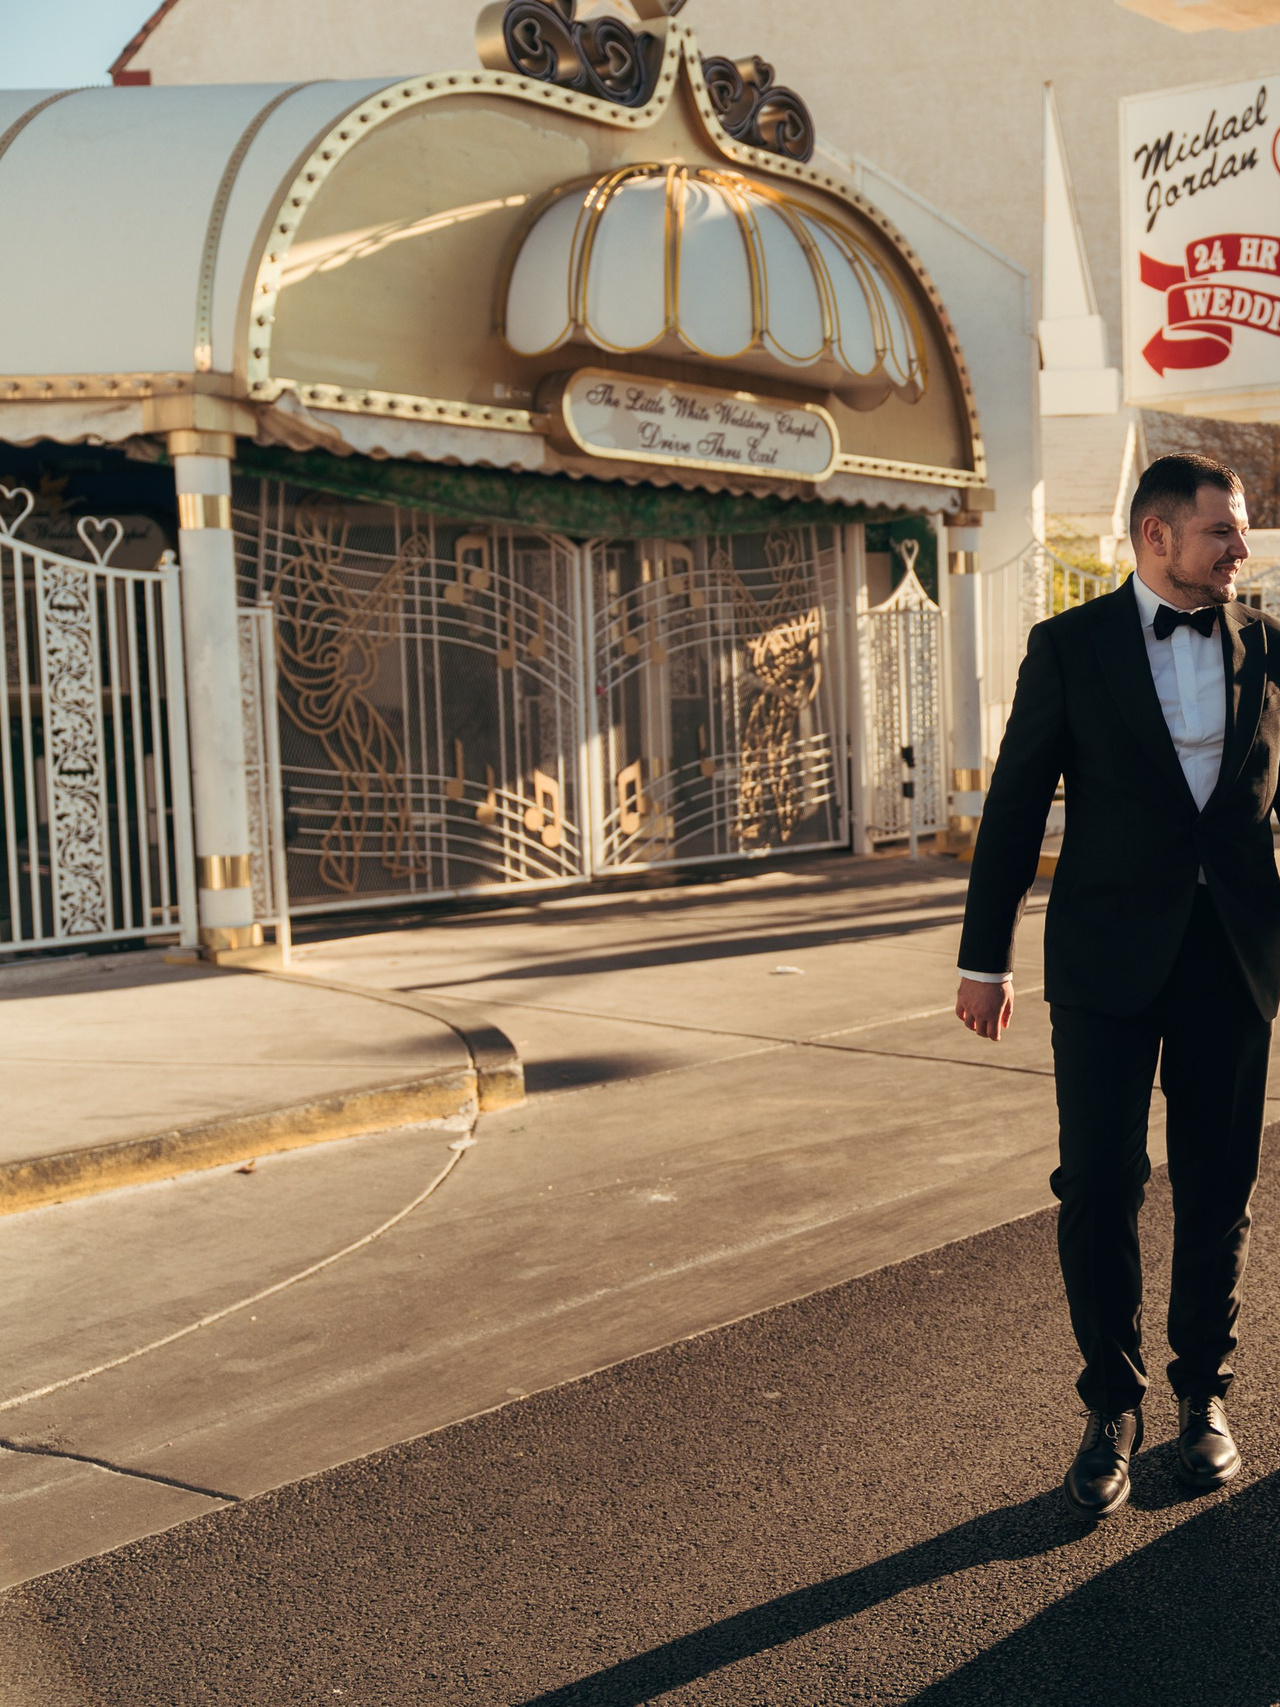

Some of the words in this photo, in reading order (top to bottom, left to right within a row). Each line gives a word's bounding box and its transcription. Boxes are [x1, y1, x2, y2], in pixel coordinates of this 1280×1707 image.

[1134, 85, 1268, 180] Michael
[1145, 147, 1258, 234] Jordan
[1193, 243, 1226, 272] 24
[1238, 237, 1280, 271] HR
[585, 383, 620, 408] The
[625, 386, 666, 415] Little
[670, 394, 711, 422] White
[713, 401, 771, 438] Wedding
[774, 411, 819, 443] Chapel
[637, 421, 692, 455] Drive
[696, 432, 743, 461] Thru
[746, 435, 780, 465] Exit
